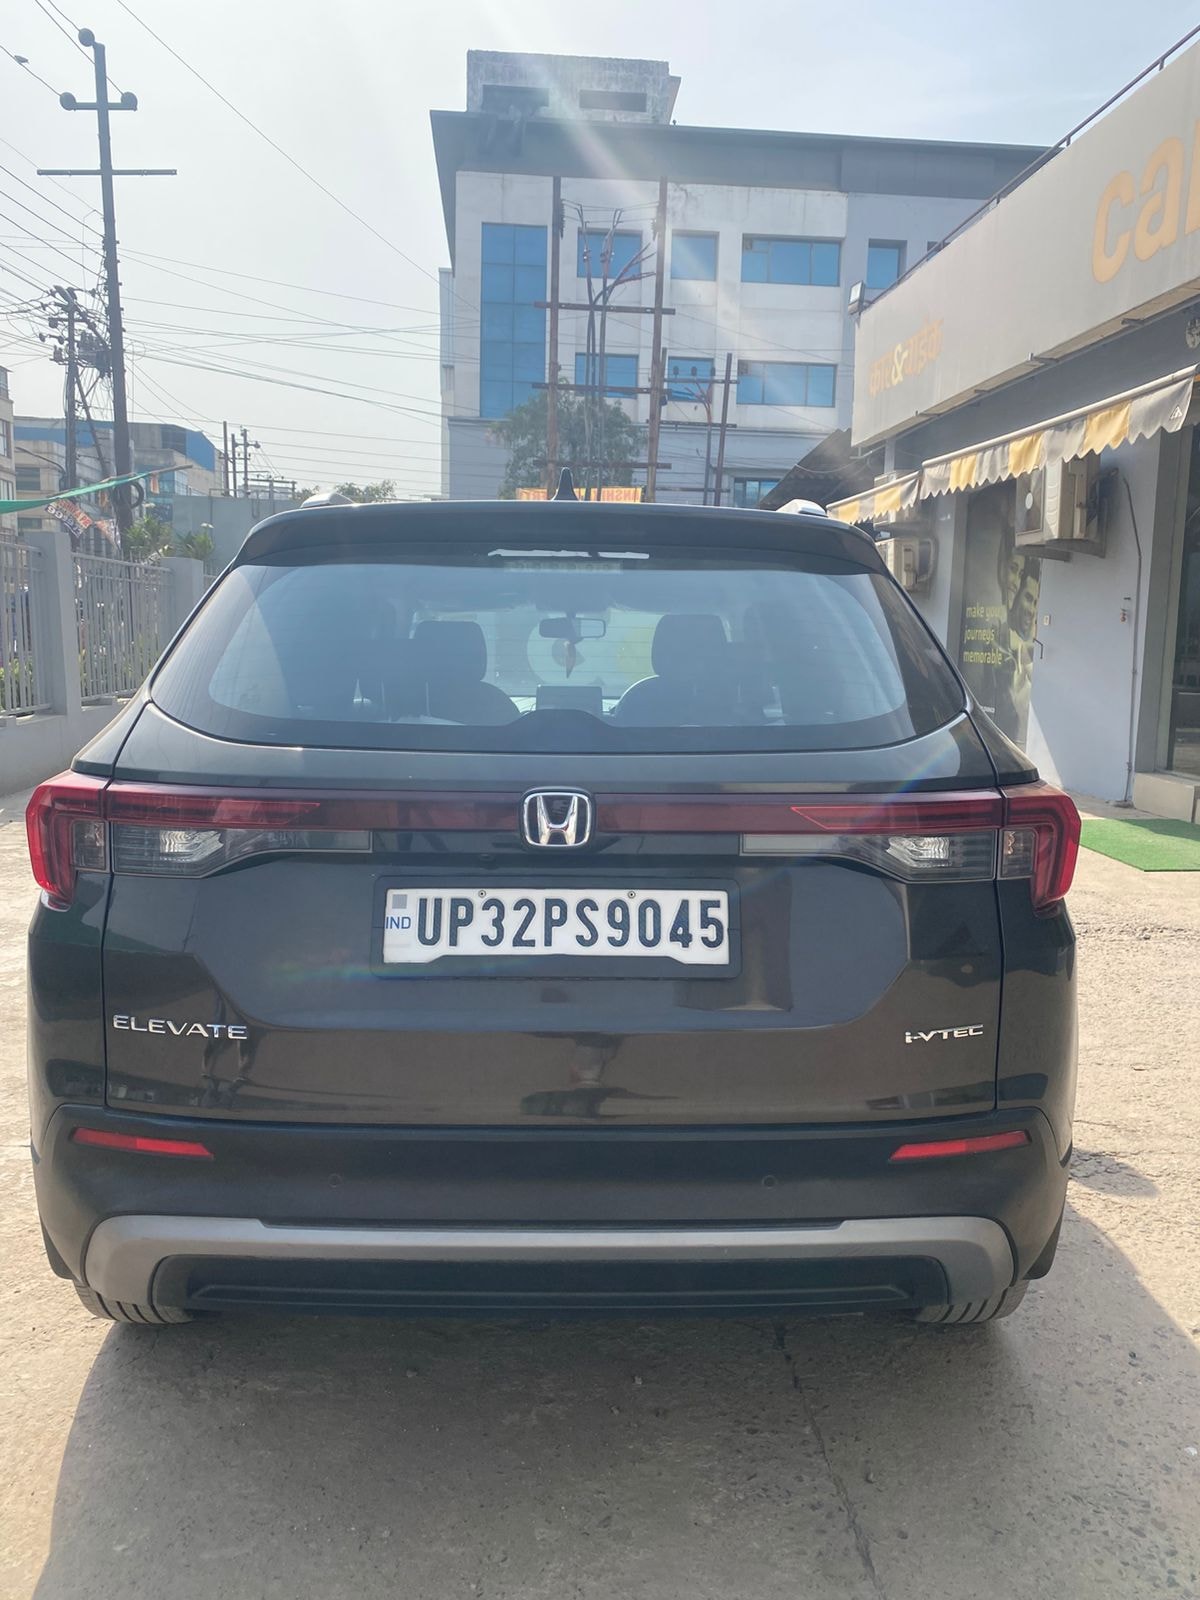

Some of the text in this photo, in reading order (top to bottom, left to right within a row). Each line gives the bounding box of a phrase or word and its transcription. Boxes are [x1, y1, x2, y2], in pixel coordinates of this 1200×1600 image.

[966, 602, 985, 618] make
[964, 625, 995, 645] journeys
[962, 648, 1003, 665] memorable
[385, 915, 412, 931] IND
[416, 897, 725, 949] UP32PS9045
[113, 1014, 248, 1040] ELEVATE
[905, 1024, 984, 1043] i-VTEC
